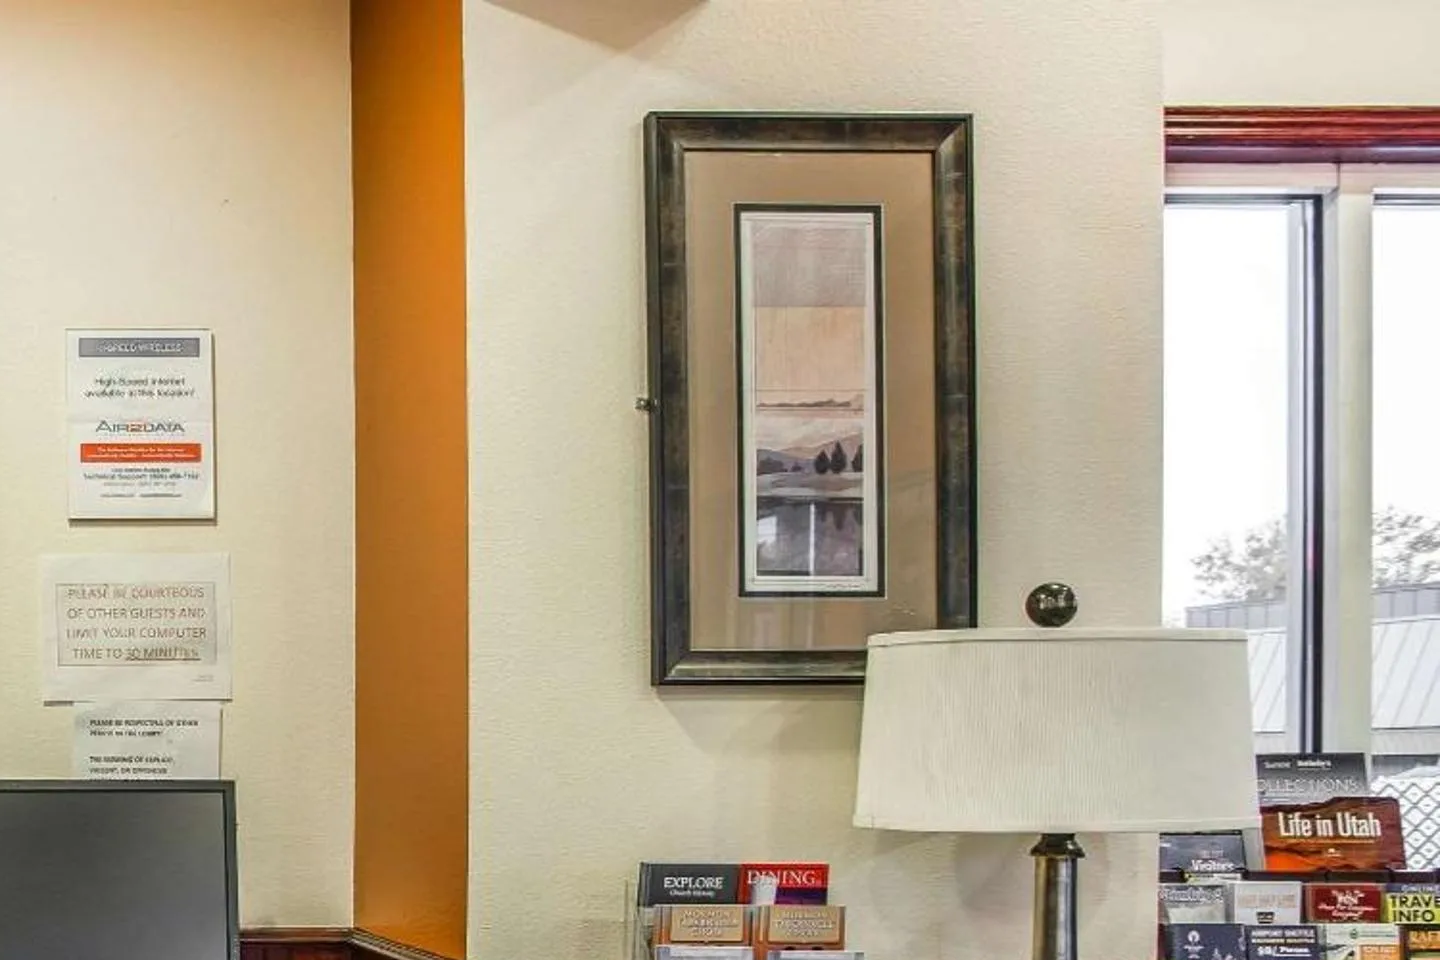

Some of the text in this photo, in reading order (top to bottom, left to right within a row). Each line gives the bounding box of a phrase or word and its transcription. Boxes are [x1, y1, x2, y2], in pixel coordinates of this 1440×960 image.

[67, 588, 108, 599] PLEASE
[131, 587, 205, 599] COURTEOUS
[67, 607, 205, 619] OF OTHER GUESTS AND
[67, 627, 206, 639] LIMIT YOUR COMPUTER
[73, 648, 102, 659] TIME
[107, 648, 122, 659] TO
[143, 648, 199, 659] MINUTES
[1278, 811, 1382, 837] Life in Utah
[664, 877, 724, 889] EXPLORE
[1394, 910, 1435, 922] INFO
